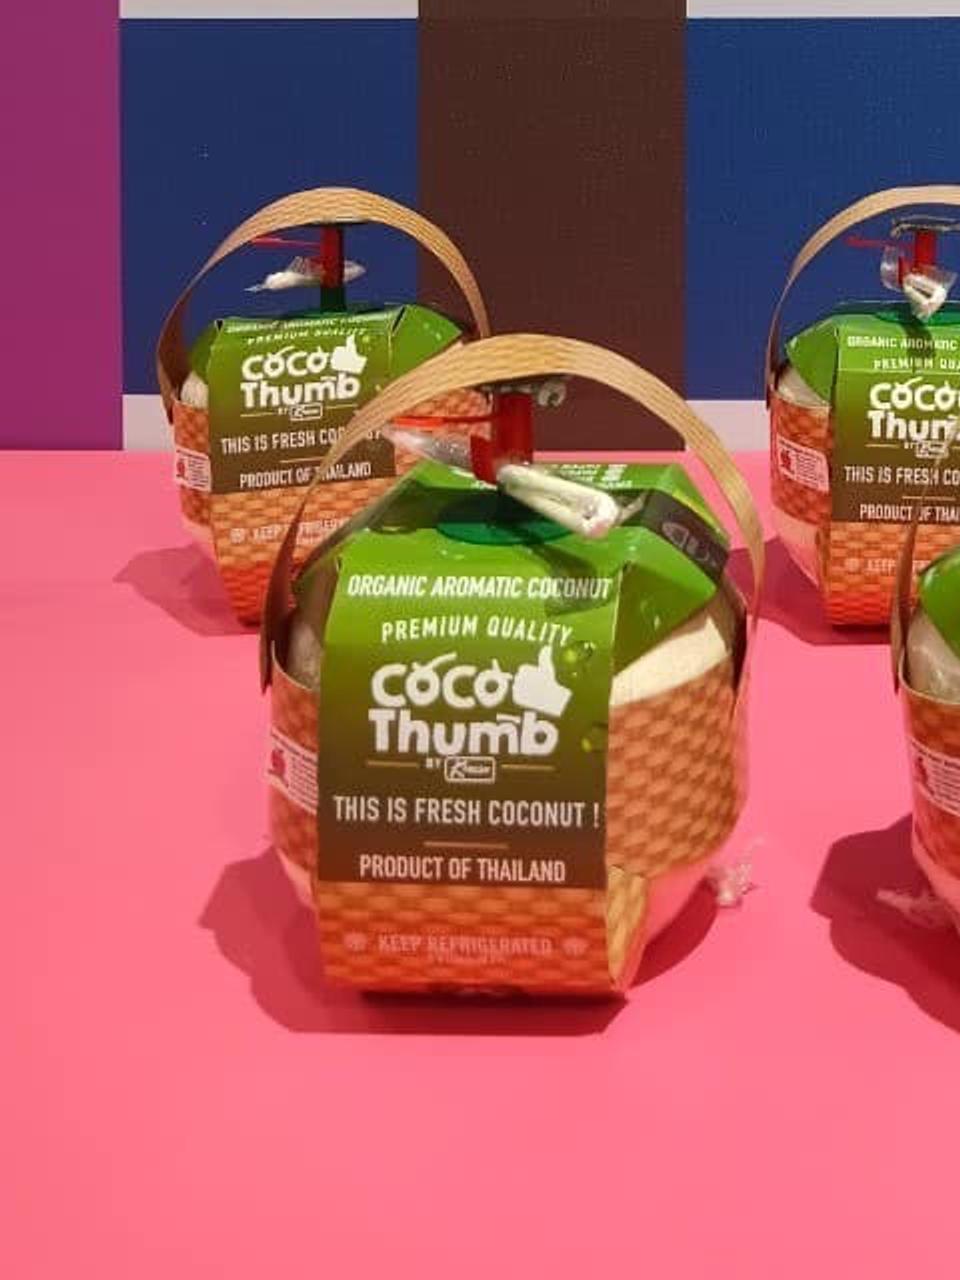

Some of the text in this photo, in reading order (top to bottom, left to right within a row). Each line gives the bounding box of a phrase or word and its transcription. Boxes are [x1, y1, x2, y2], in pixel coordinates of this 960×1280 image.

[847, 335, 897, 348] ORGANIC
[901, 337, 957, 351] AROMATIC
[874, 358, 933, 371] PREMIUM
[240, 372, 360, 408] Thumb
[221, 437, 250, 455] THIS
[254, 434, 268, 451] IS
[272, 430, 317, 450] FRESH
[239, 469, 293, 488] PRODUCT
[296, 468, 311, 484] OF
[844, 465, 874, 483] THIS
[877, 467, 891, 484] IS
[896, 468, 939, 485] FRESH
[860, 503, 913, 521] PRODUCT
[348, 574, 613, 600] ORGANIC AROMATIC COCONUT
[381, 615, 573, 646] PREMIUM QUALITY
[368, 708, 559, 756] Thumb
[333, 795, 600, 828] THIS IS FRESH COCONUT !
[360, 854, 566, 882] PRODUCT OF THAILAND
[378, 934, 553, 955] KEEP REFRIGERATED
